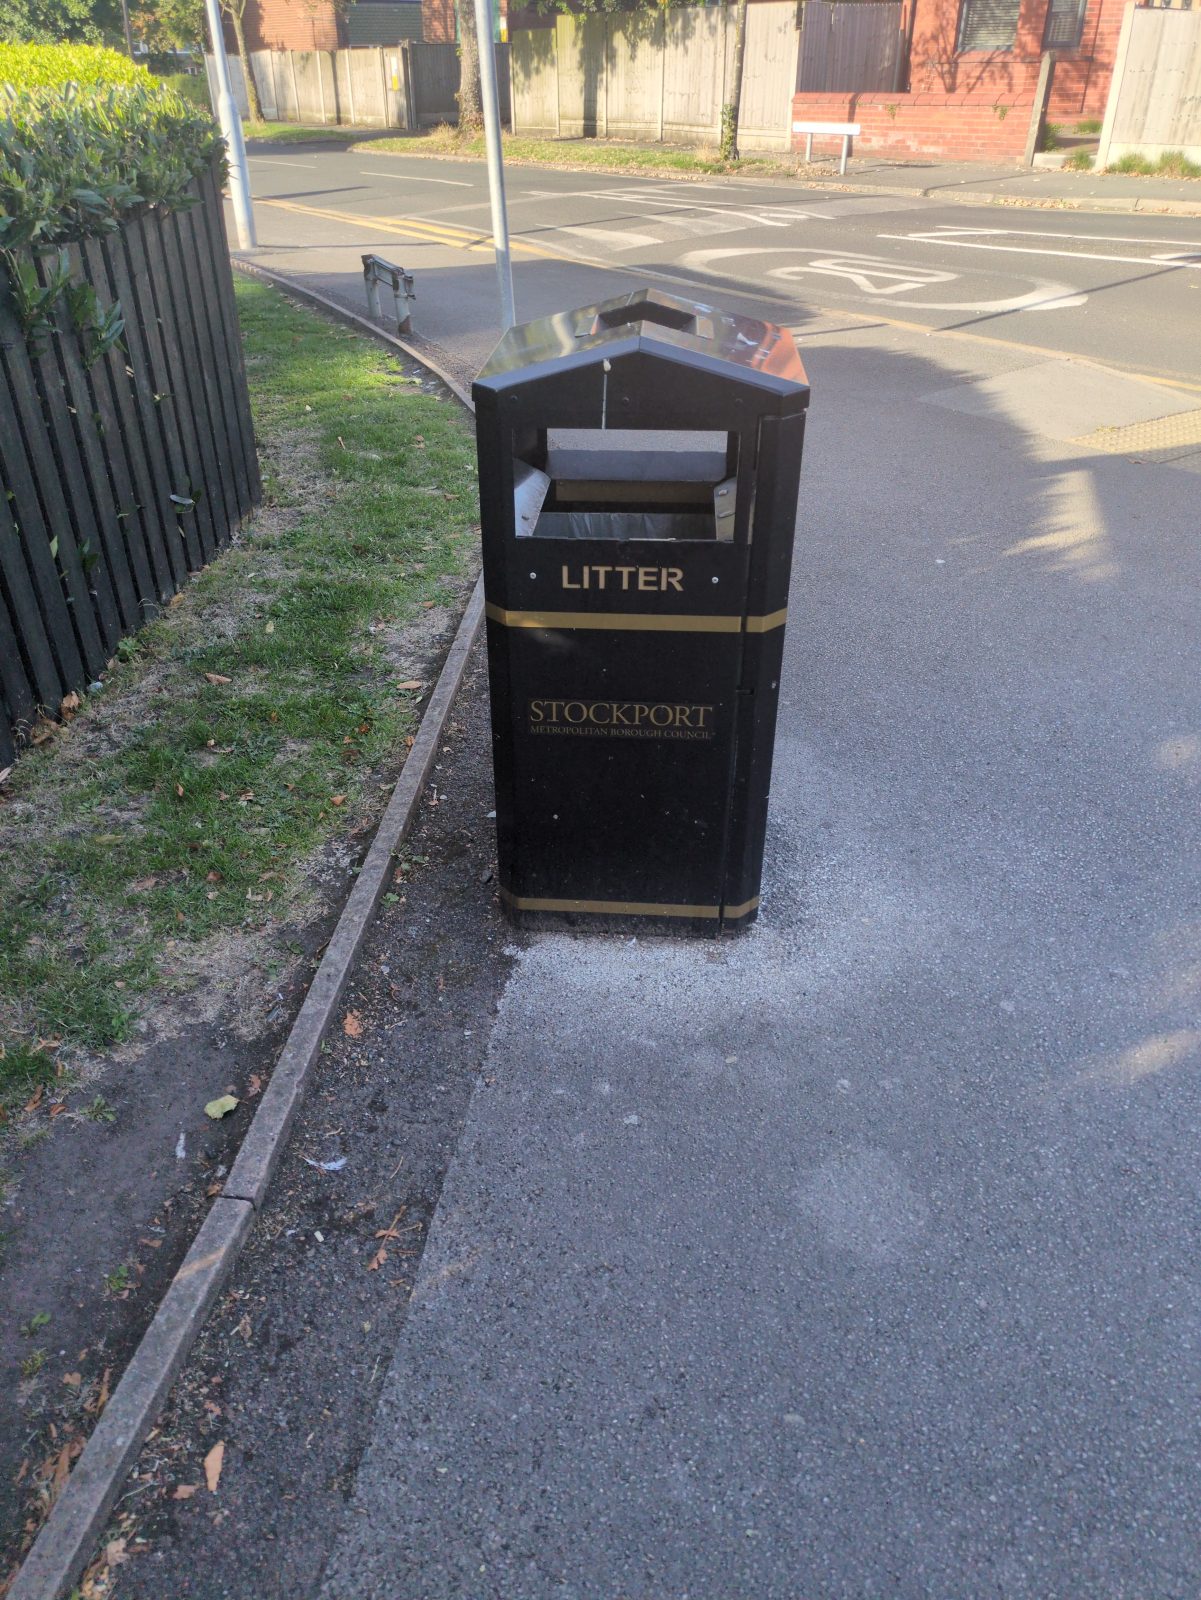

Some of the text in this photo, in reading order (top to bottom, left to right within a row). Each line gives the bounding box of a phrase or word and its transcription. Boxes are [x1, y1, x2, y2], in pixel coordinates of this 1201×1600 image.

[765, 258, 961, 295] 20
[561, 565, 684, 592] LITTER
[530, 700, 713, 727] STOCKPORT
[530, 725, 712, 740] METROPOLITAN BOROUGH COUNCIL
